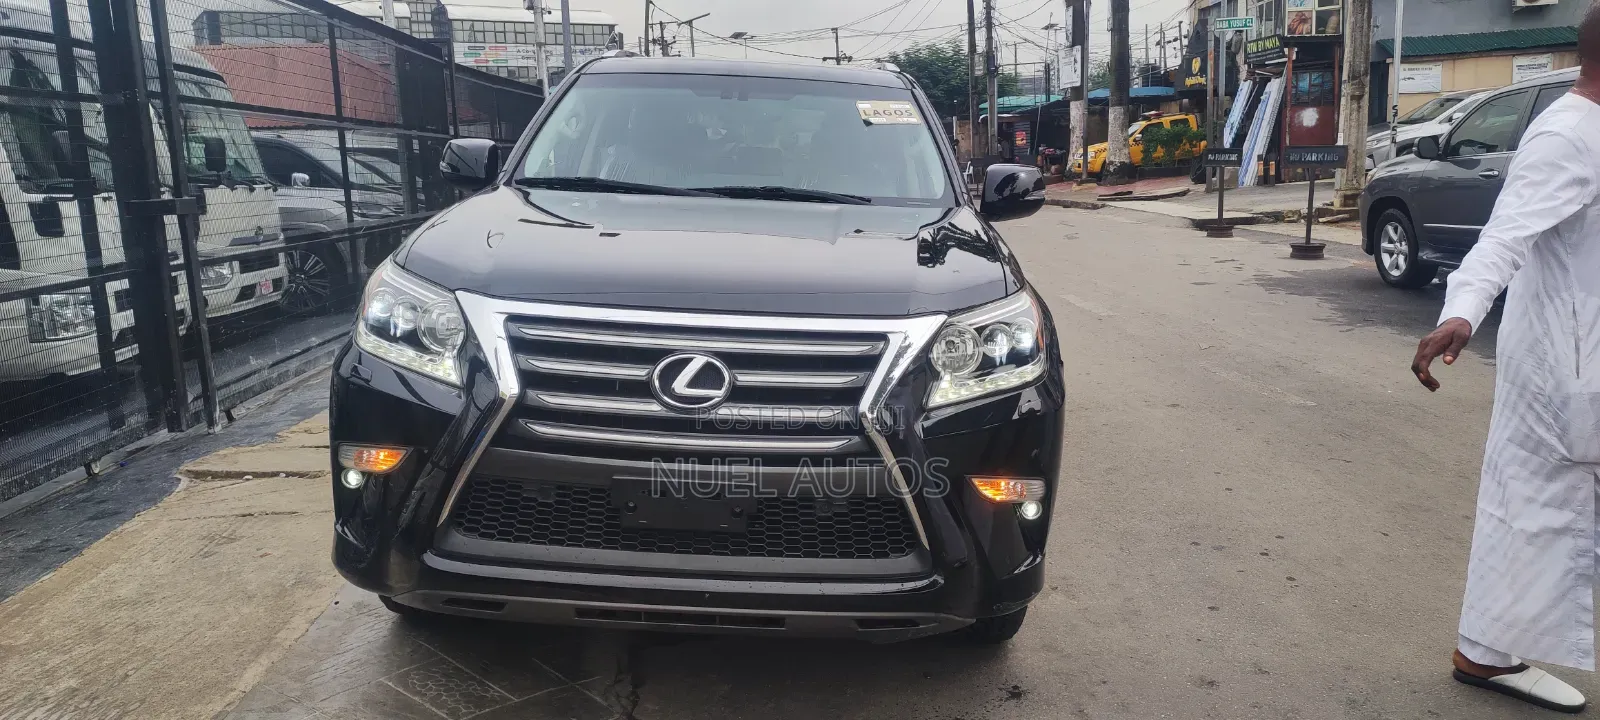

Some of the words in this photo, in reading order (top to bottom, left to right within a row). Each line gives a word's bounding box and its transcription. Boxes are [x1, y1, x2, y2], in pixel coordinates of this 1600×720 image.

[1230, 19, 1246, 28] YUSUF
[1258, 40, 1265, 51] BY
[1265, 36, 1280, 49] MAYA
[1301, 152, 1339, 161] PARKING
